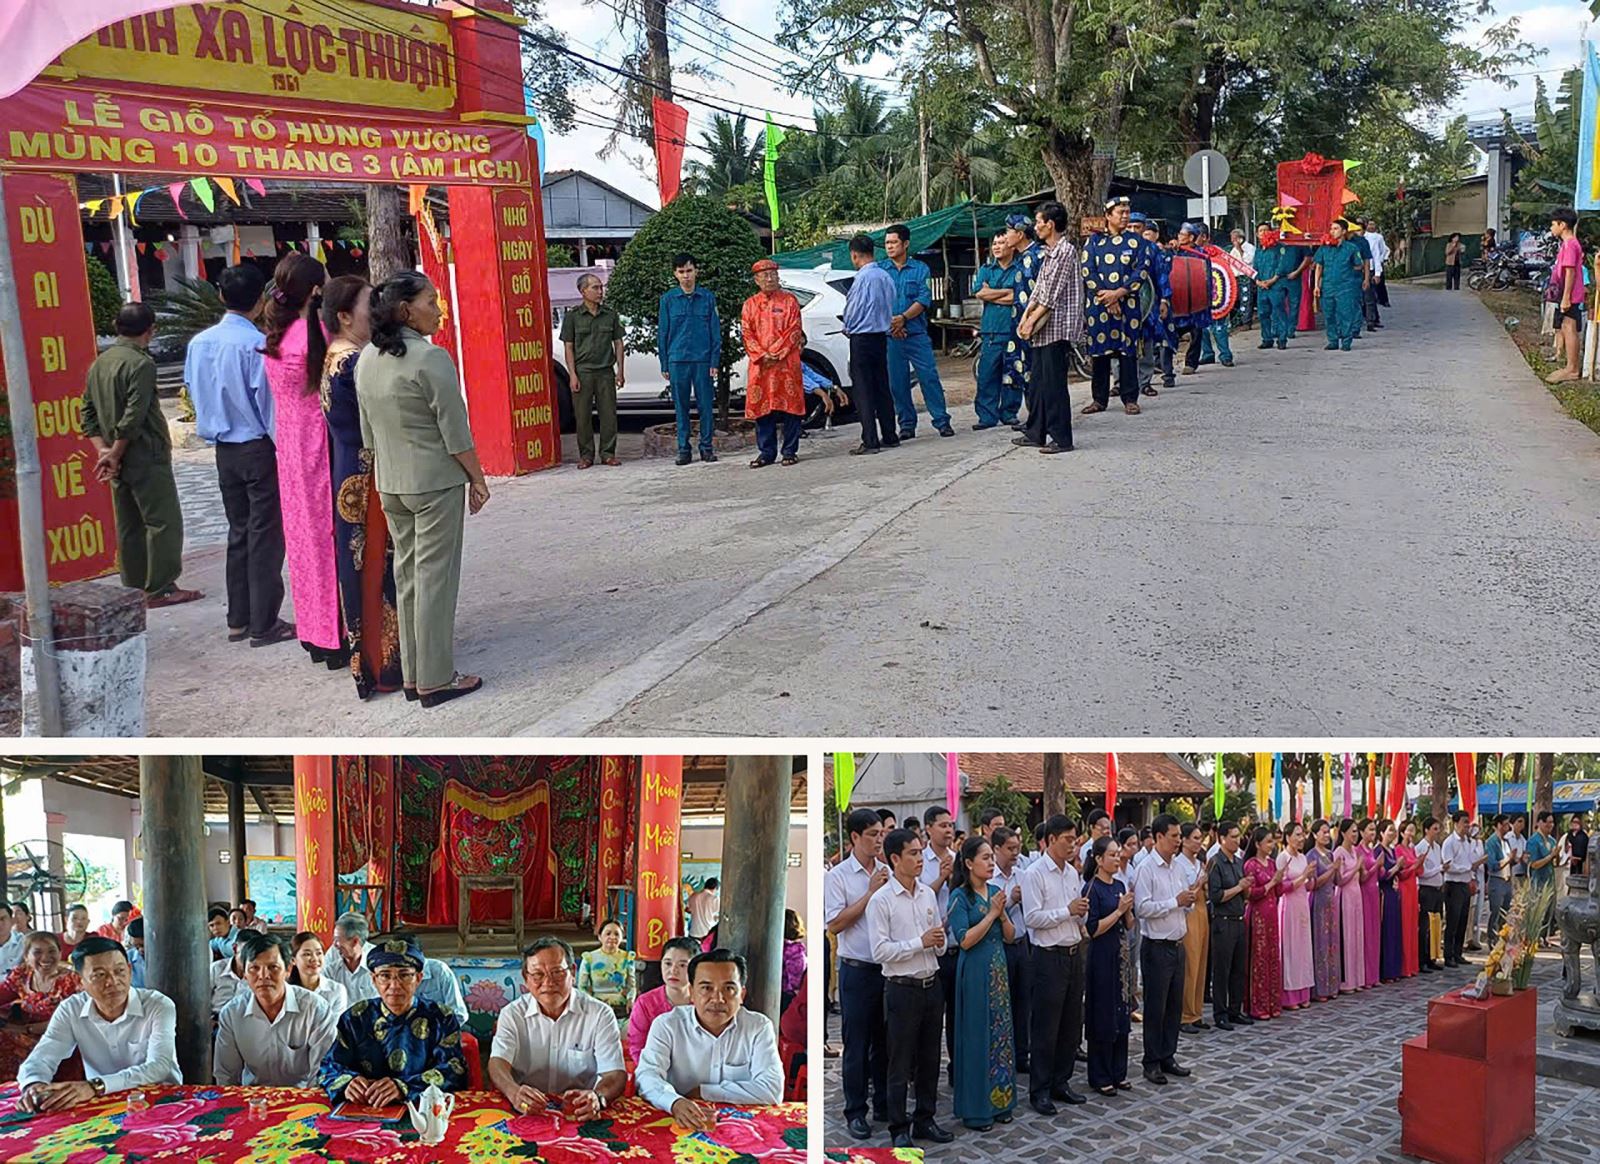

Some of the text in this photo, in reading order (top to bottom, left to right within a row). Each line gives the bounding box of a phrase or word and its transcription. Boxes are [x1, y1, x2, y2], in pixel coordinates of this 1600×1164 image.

[263, 4, 451, 92] LỘC-THUẬN
[65, 93, 491, 153] LỄ GIỖ TỔ HÙNG VƯƠNG
[9, 126, 523, 184] MÙNG 10 THÁNG 3 (ÂM LỊCH)
[19, 195, 55, 244] DÙ
[34, 271, 60, 308] AI
[41, 336, 67, 373] ĐI
[502, 201, 551, 459] NHỚ NGÀY GIỖ TỔ MÙNG MƯỜI THÁNG BA
[52, 450, 88, 498] VỀ
[47, 514, 104, 564] XUÔI
